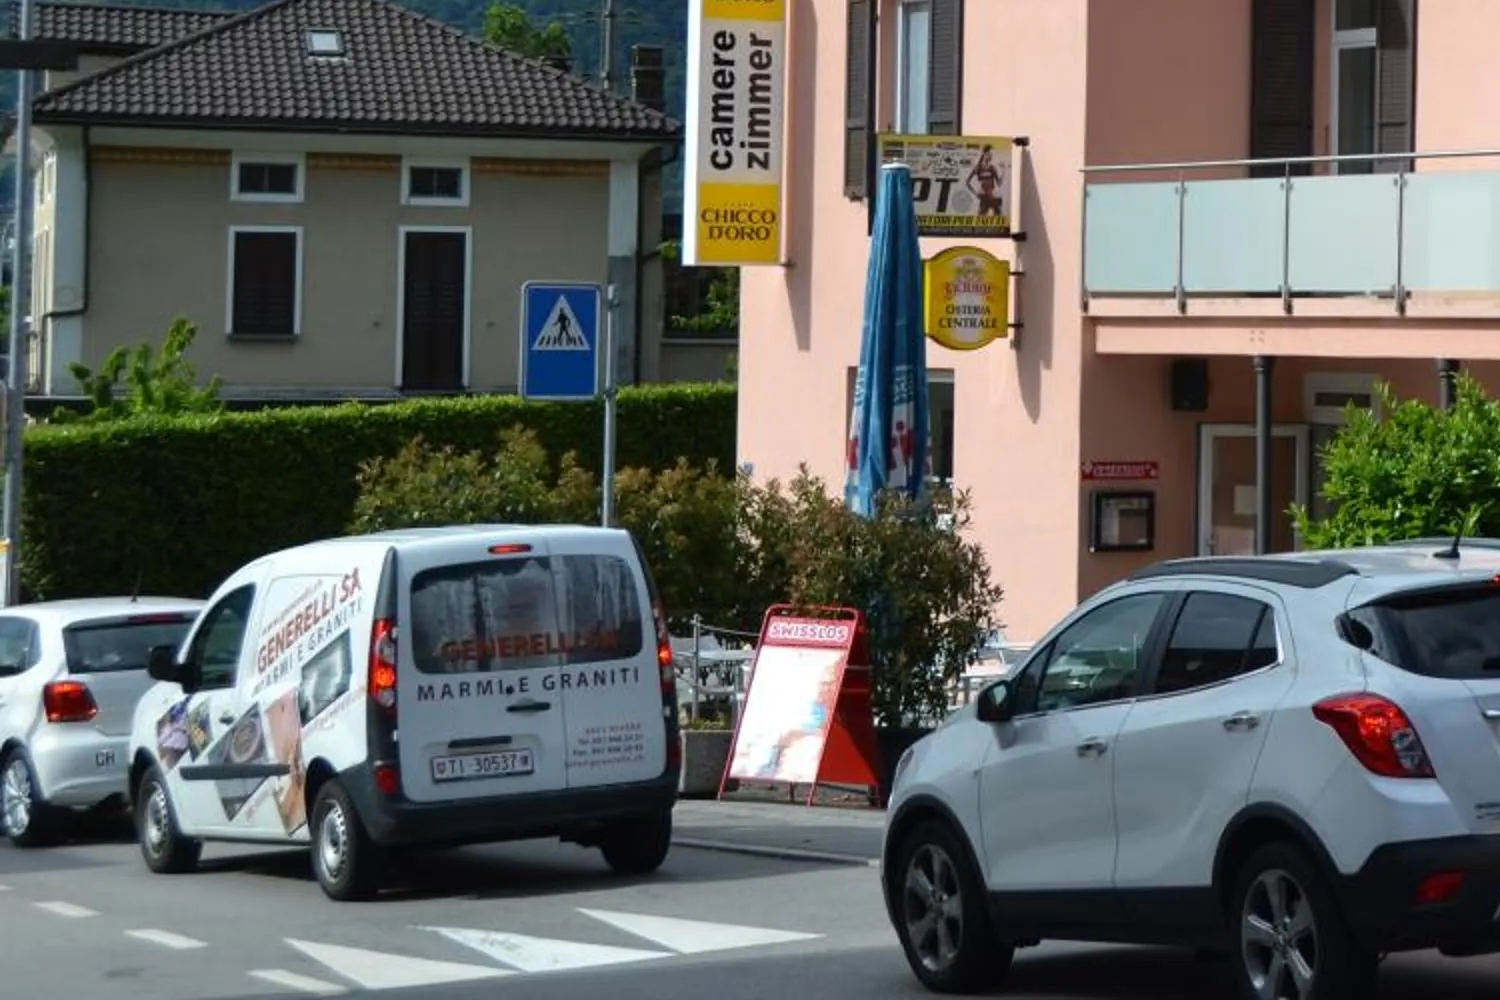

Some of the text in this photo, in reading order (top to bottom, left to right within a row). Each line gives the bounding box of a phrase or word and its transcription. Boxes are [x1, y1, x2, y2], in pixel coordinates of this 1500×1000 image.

[710, 29, 736, 170] camere
[739, 32, 772, 170] zimmer
[701, 208, 776, 224] CHICCO
[938, 317, 997, 329] CENTRALE
[257, 583, 338, 674] GENERELLI
[417, 667, 640, 701] MARMI E GRANITI
